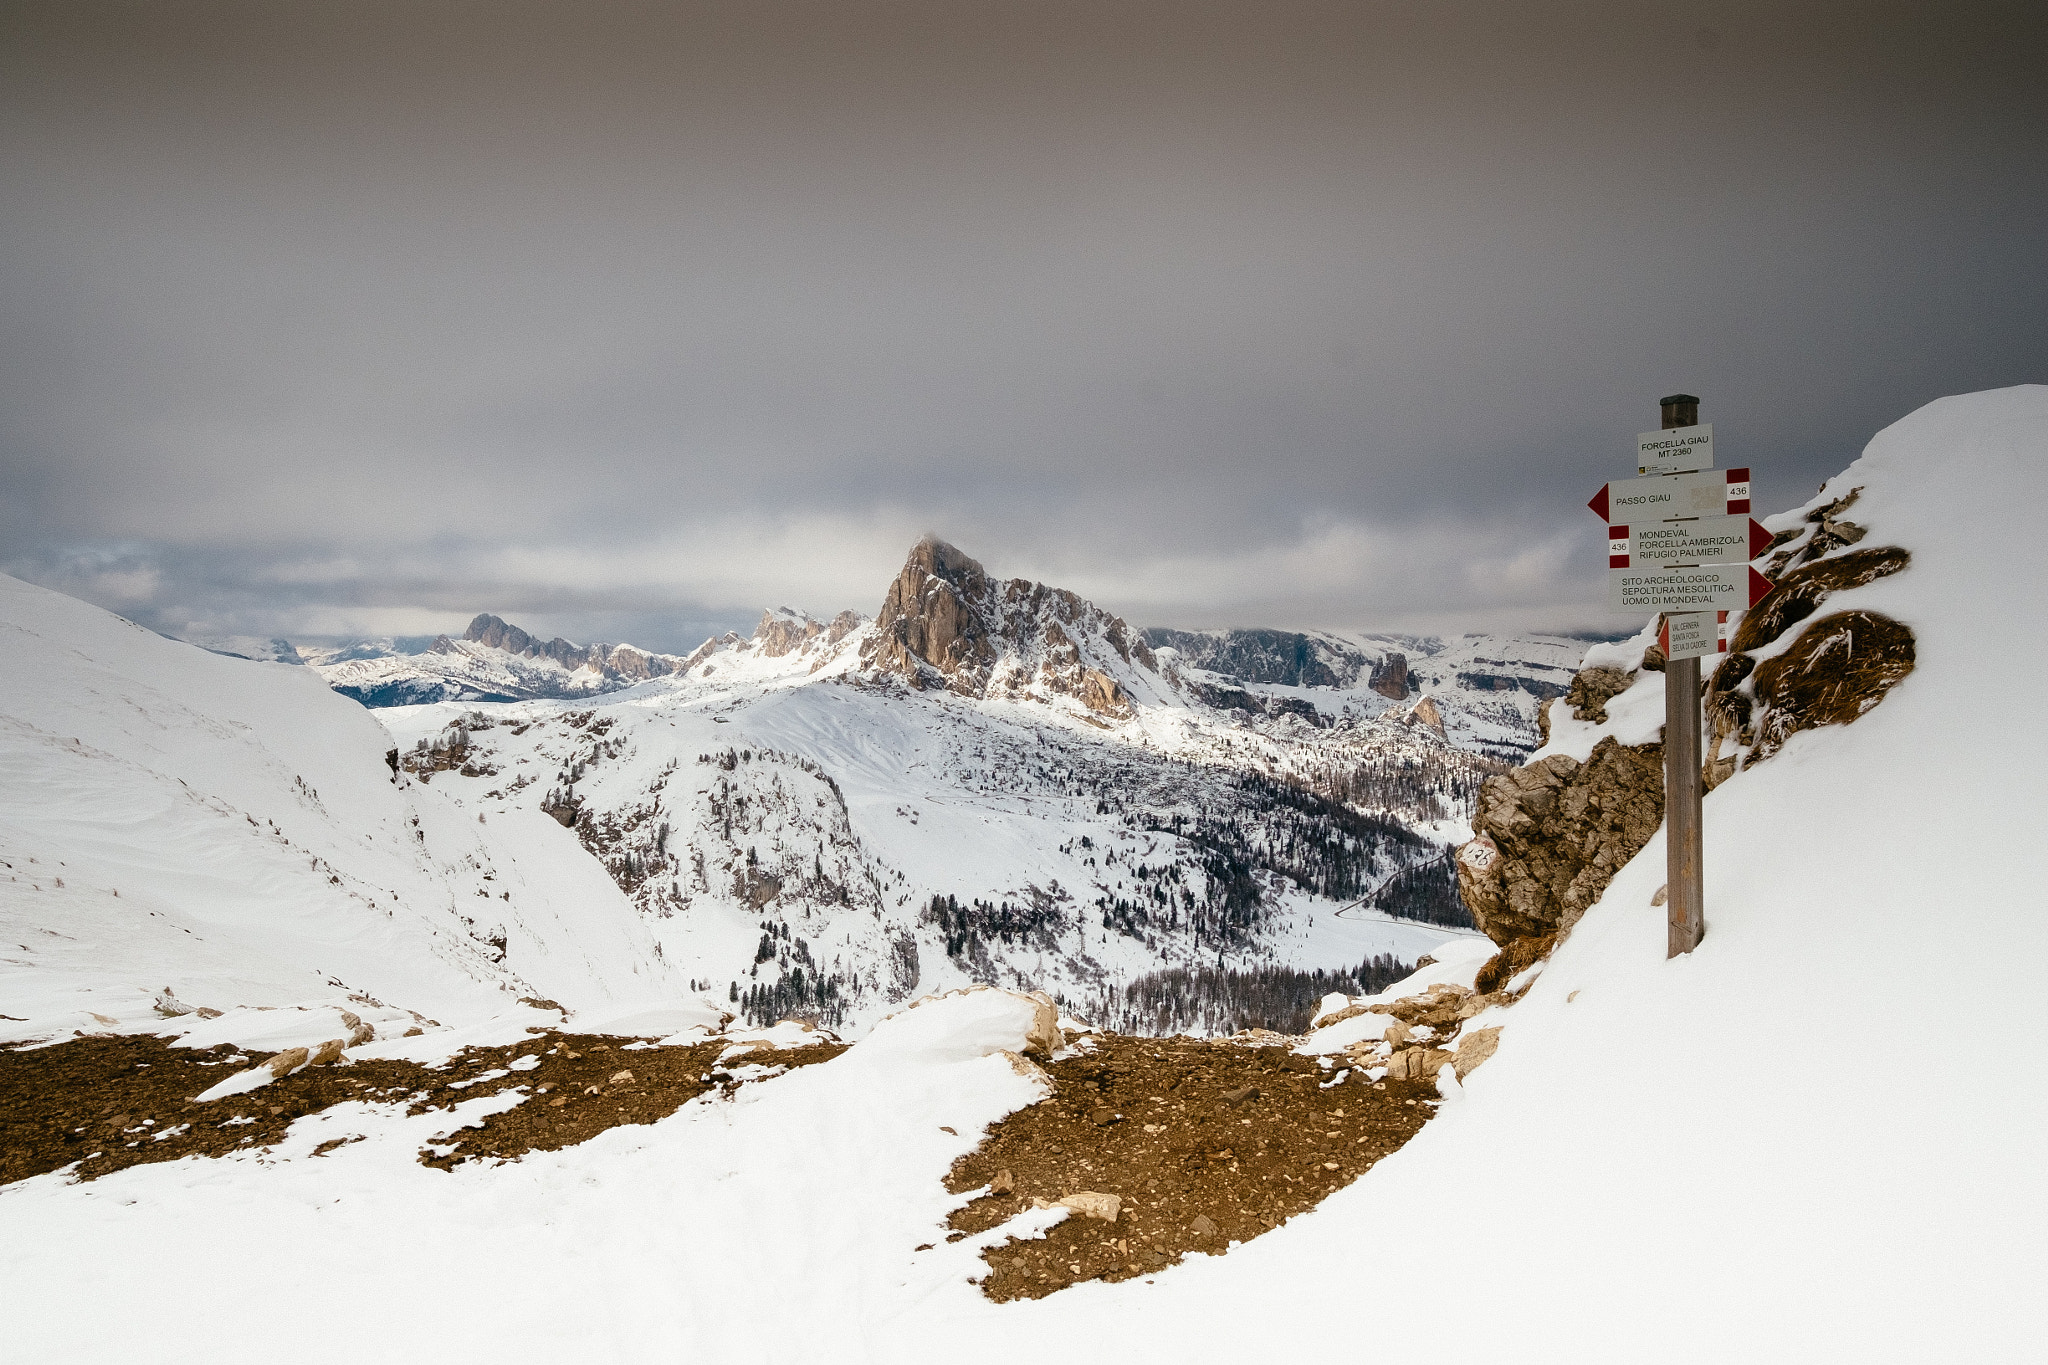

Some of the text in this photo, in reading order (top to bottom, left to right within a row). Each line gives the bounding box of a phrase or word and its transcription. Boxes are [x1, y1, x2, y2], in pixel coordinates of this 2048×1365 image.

[1641, 436, 1709, 451] FORCELLA GIAU
[1658, 448, 1692, 458] MT 2360
[1730, 487, 1747, 496] 436
[1616, 494, 1671, 505] PASSO GIAU
[1639, 529, 1689, 540] MONDEVAL
[1611, 543, 1627, 551] 436
[1639, 536, 1745, 549] FORCELLA AMBRIZOLA
[1639, 548, 1723, 559] RIFUGIO PALMIERI
[1622, 574, 1720, 586] SITO ARCHEOLOGICO
[1622, 584, 1735, 596] SEPOLTURA MESOLITICA
[1622, 595, 1715, 605] UOMO DI MONDEVAL
[1672, 643, 1685, 652] SELVA
[1690, 640, 1707, 650] CADORE
